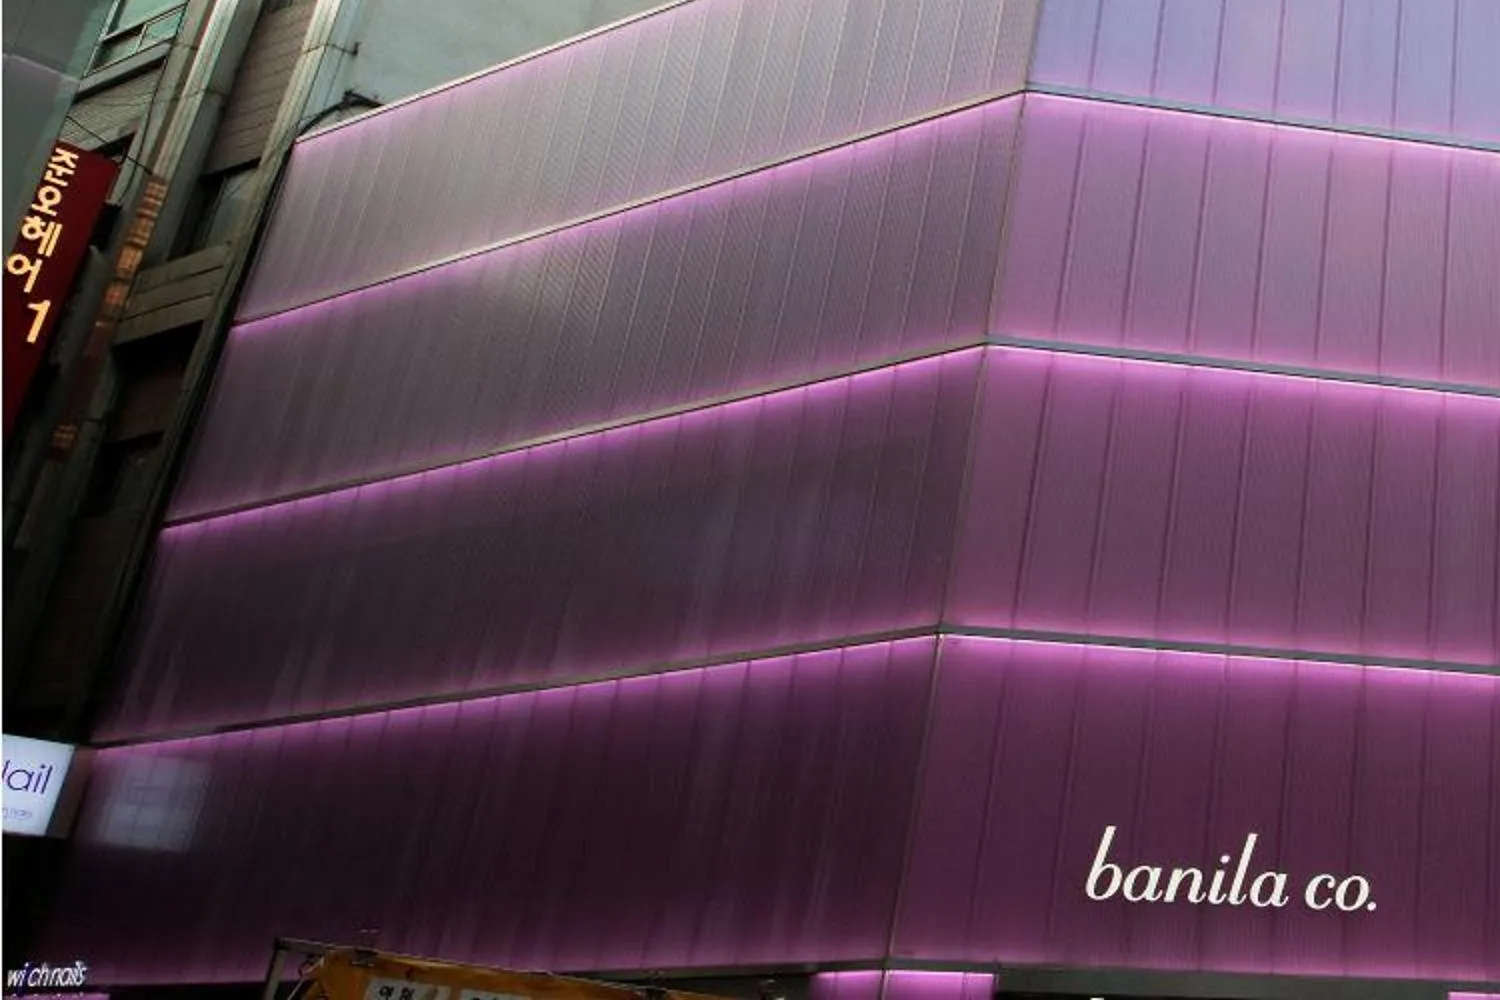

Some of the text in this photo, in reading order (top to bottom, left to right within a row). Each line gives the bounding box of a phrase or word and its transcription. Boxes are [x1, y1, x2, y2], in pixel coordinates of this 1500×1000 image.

[7, 147, 79, 343] 준오헤어 1
[1085, 825, 1377, 911] banila co.
